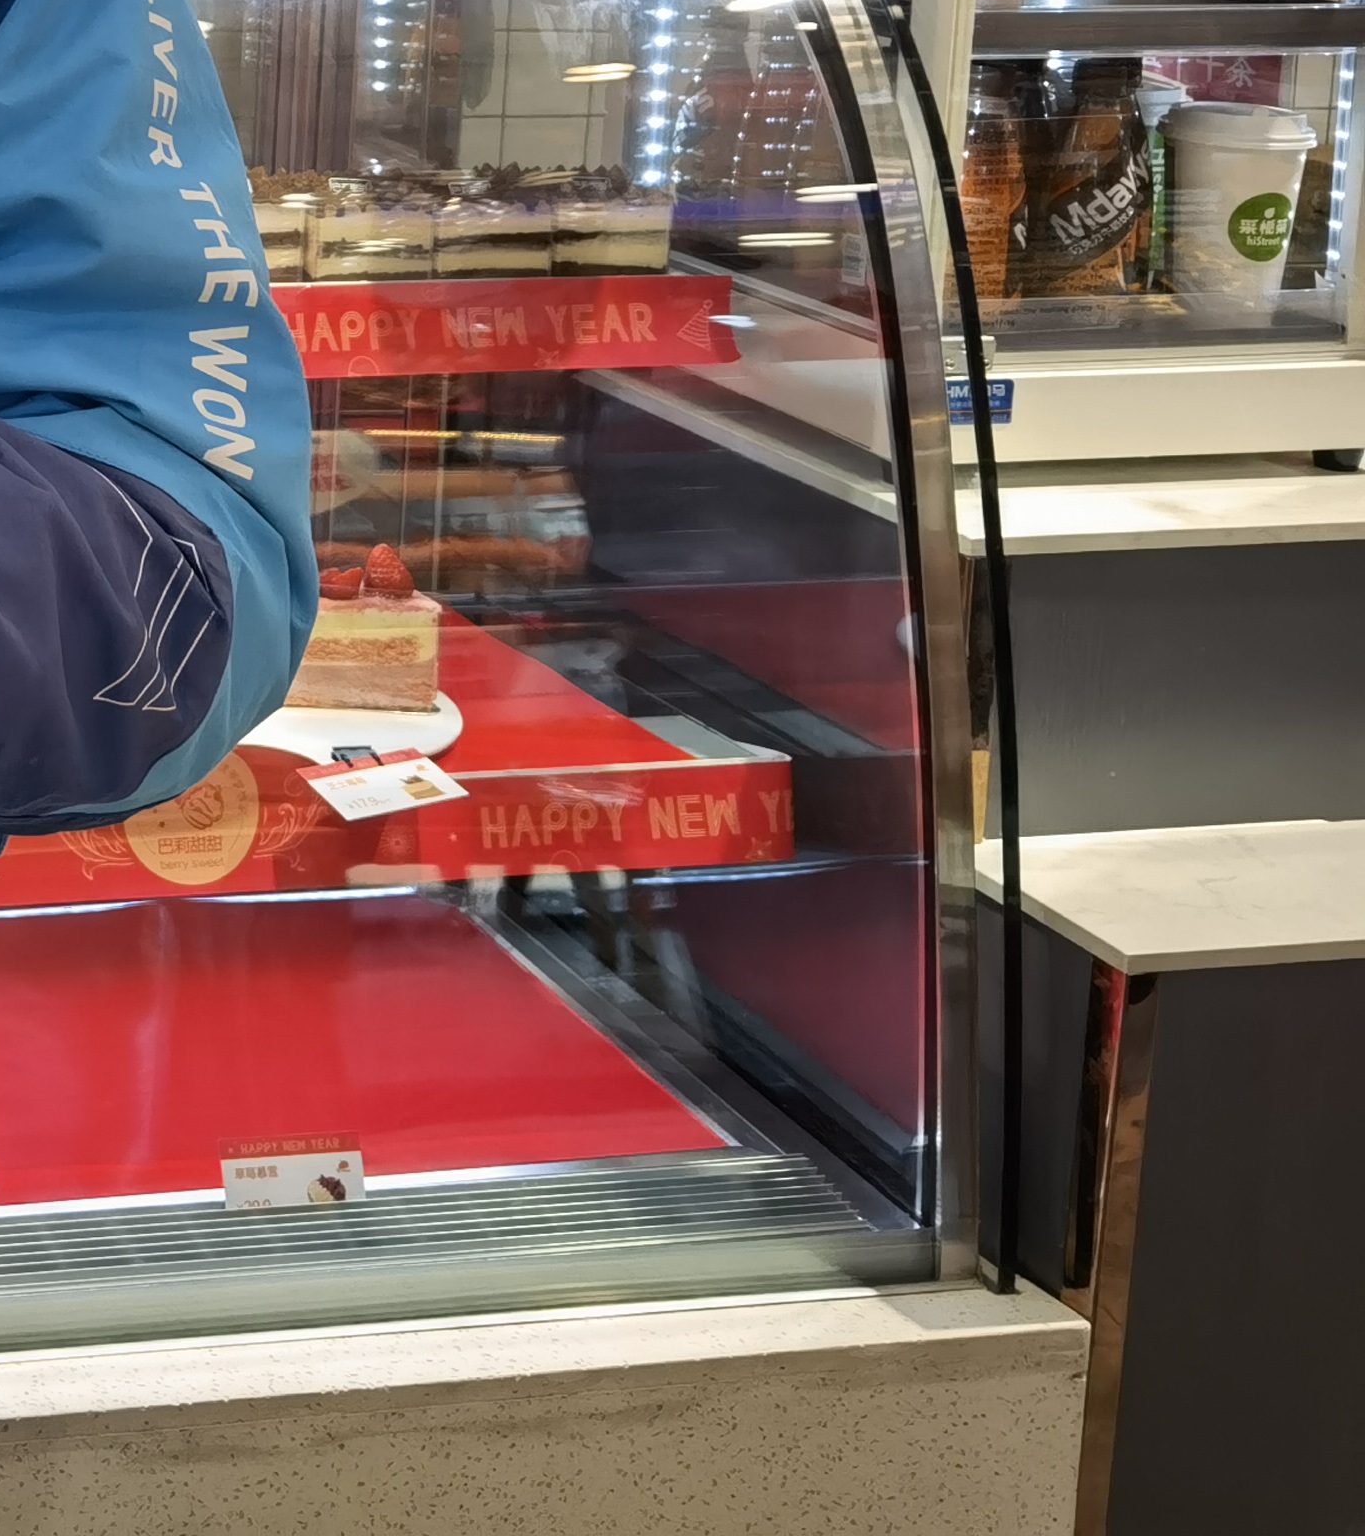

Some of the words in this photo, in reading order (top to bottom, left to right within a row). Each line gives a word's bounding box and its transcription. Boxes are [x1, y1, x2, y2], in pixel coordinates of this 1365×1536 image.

[179, 182, 258, 308] THE
[288, 309, 421, 353] HAPPY
[441, 305, 529, 349] NEW
[544, 302, 658, 346] YEAR
[188, 325, 257, 481] WON
[157, 835, 223, 855] 巴莉甜甜
[480, 801, 625, 849] HAPPY
[648, 793, 741, 840] NEW
[159, 860, 190, 871] berry
[192, 857, 226, 867] sweet
[240, 1141, 278, 1154] HAPPY
[282, 1139, 306, 1151] NEW
[310, 1137, 340, 1150] YEAR
